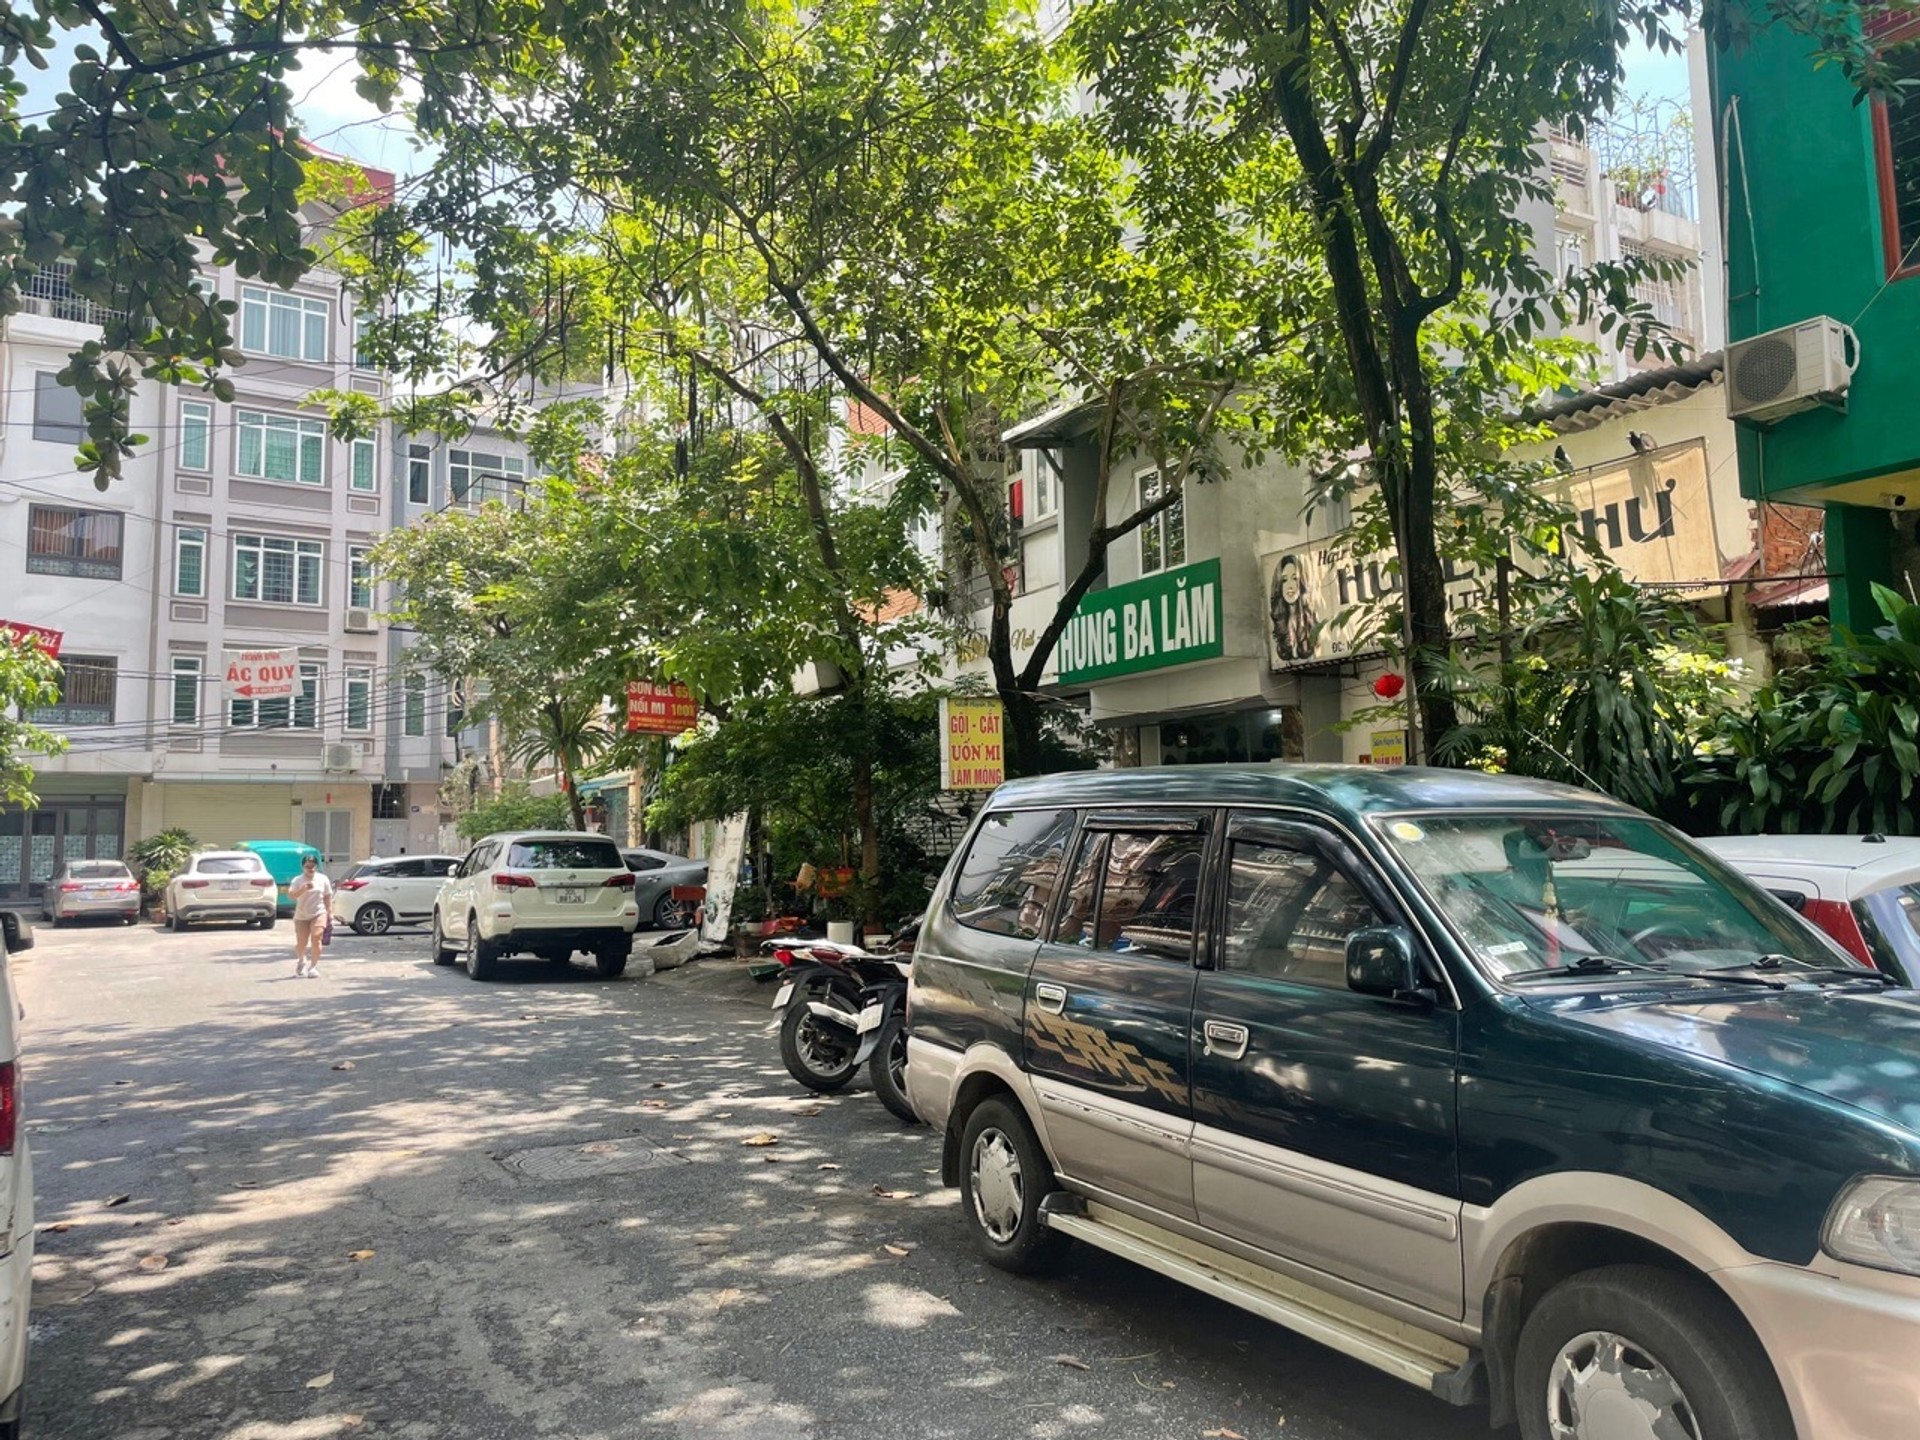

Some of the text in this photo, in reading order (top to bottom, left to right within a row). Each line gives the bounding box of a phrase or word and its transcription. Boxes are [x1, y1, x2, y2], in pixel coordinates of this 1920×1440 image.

[1060, 604, 1118, 673] HÙNG
[1123, 598, 1155, 660] BA
[1160, 575, 1216, 653] LĂM
[226, 661, 295, 683] ẮC QUY
[629, 696, 648, 714] NỐI
[651, 701, 666, 715] MI
[950, 710, 969, 738] GỘI
[979, 709, 1000, 734] CẮT
[951, 737, 1001, 762] UỐN MI
